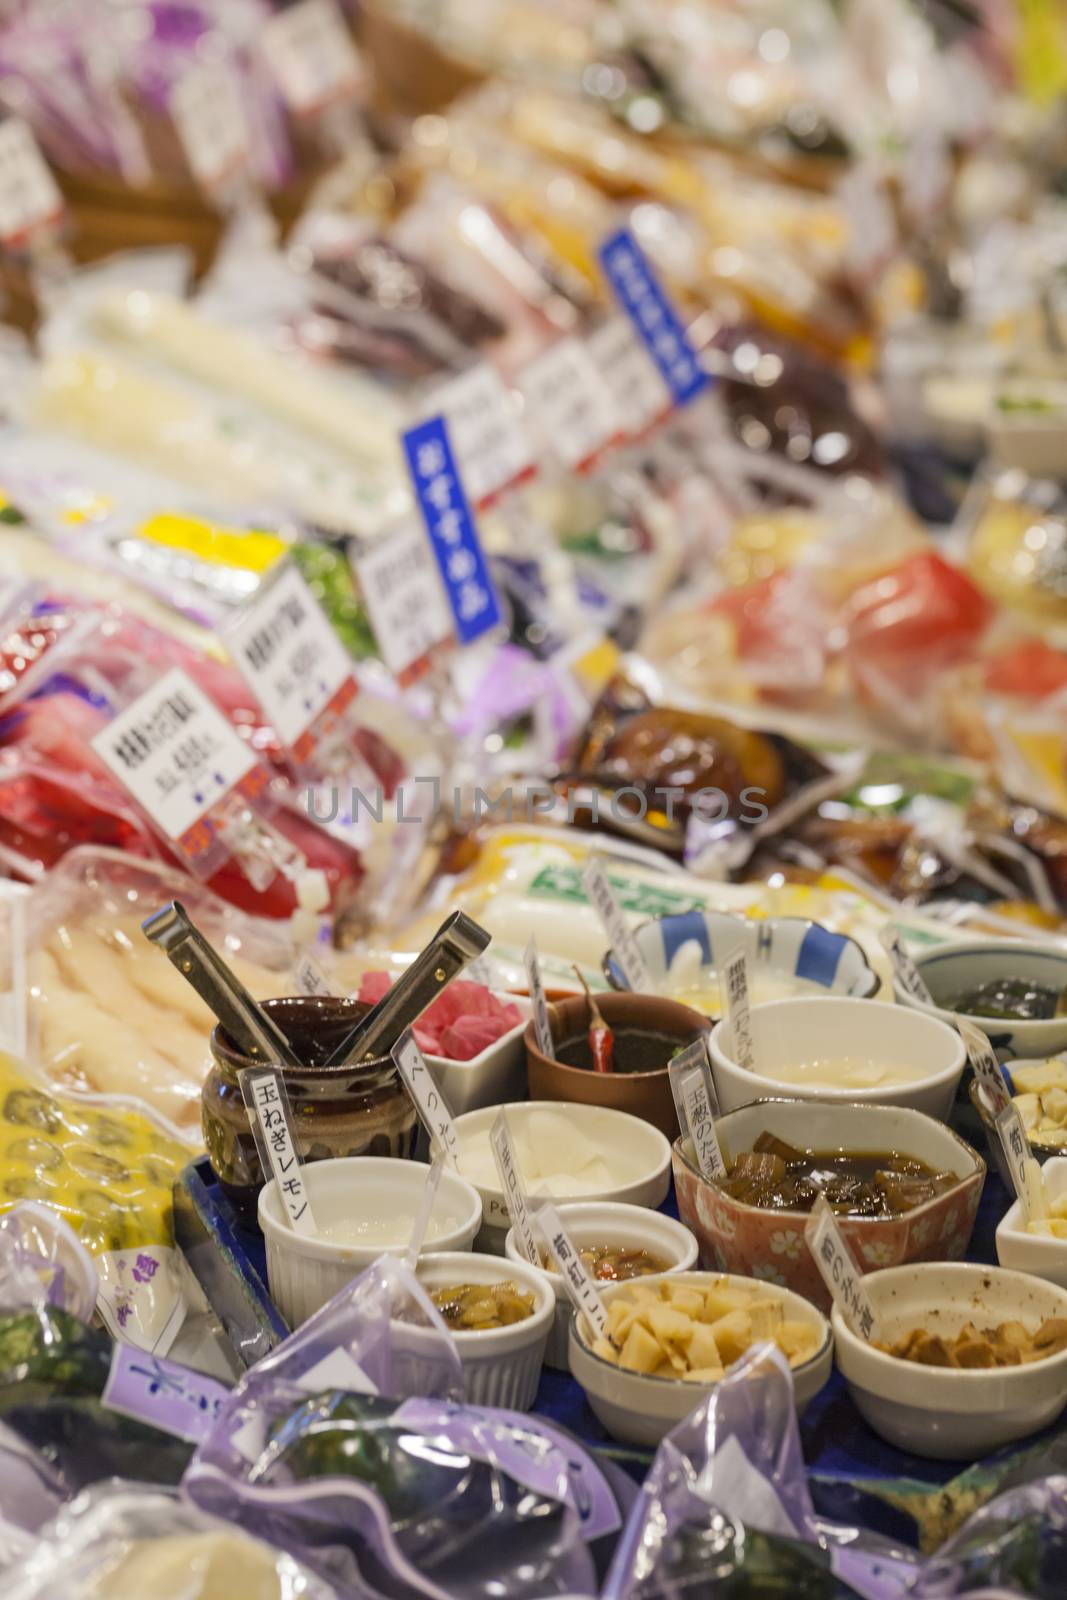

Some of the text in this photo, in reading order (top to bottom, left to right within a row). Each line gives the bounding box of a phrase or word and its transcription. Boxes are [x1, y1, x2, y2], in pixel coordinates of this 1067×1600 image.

[257, 1082, 308, 1220] 玉ねぎレモン
[688, 1089, 721, 1181] 玉葱のたま
